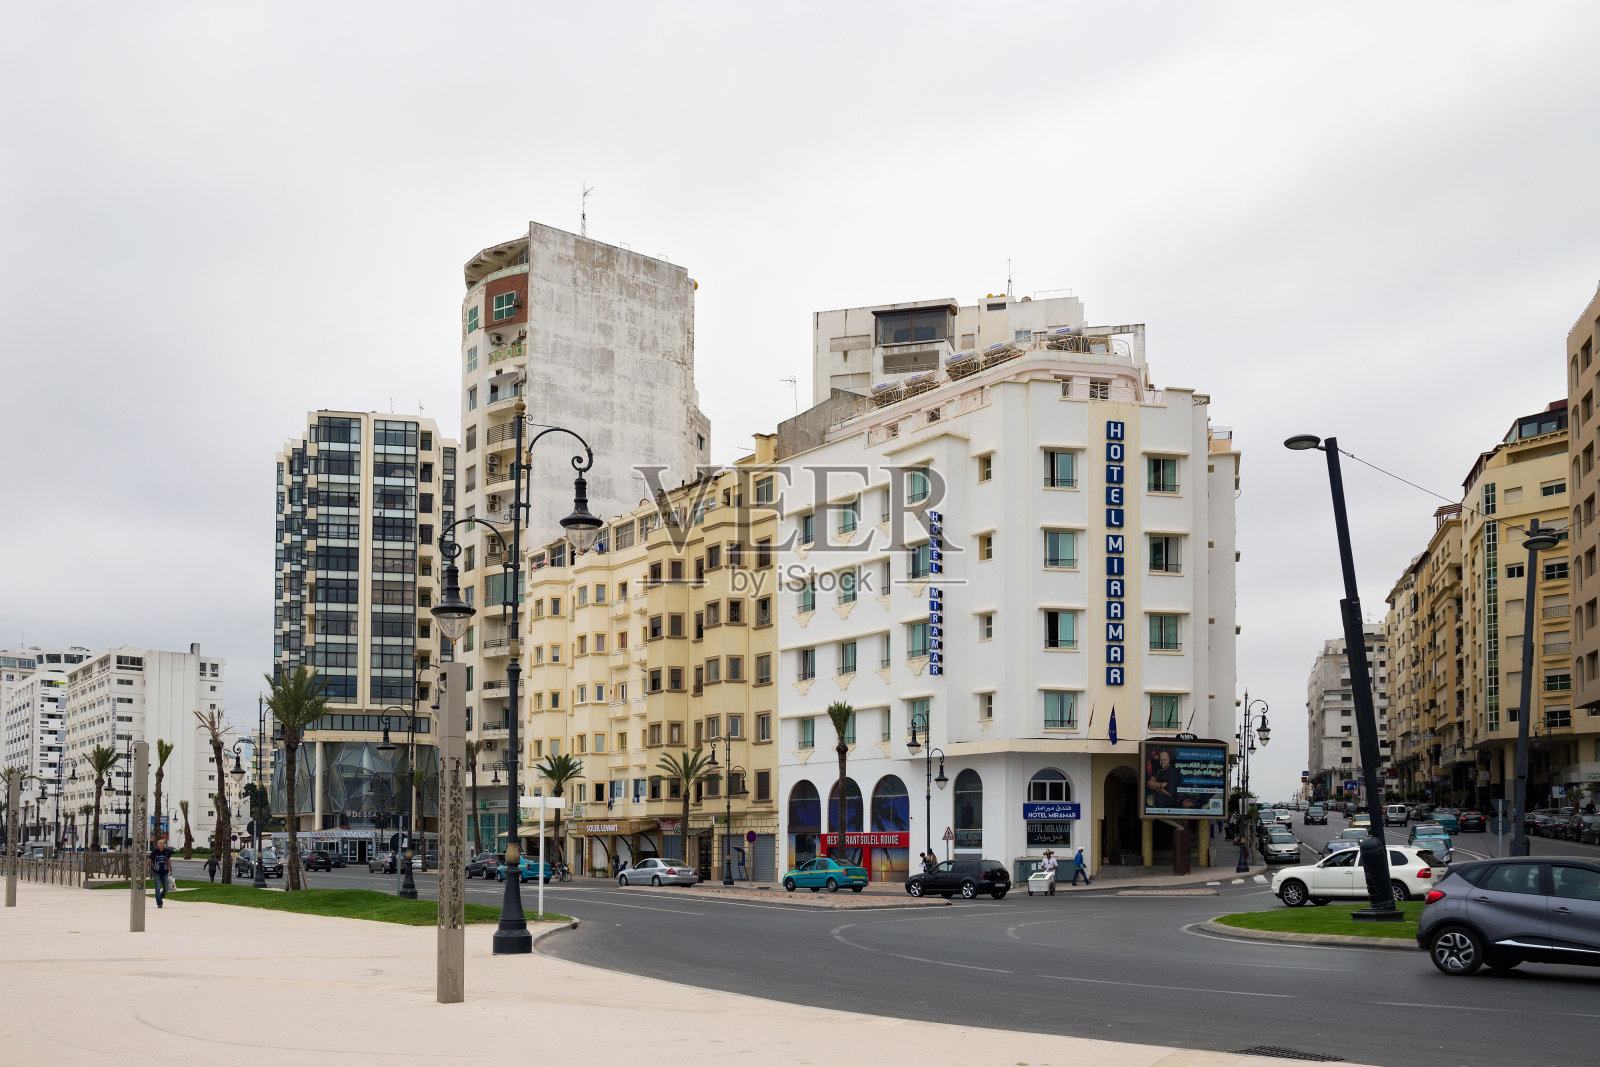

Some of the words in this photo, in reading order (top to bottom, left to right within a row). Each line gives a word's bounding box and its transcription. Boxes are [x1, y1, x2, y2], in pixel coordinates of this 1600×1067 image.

[1108, 421, 1123, 526] HOTEL
[931, 512, 939, 574] HOTEL
[931, 588, 939, 675] MIRAMAR
[1108, 536, 1123, 685] MIRAMAR
[586, 824, 601, 833] SOLEIL
[601, 824, 619, 832] LEVANT
[826, 835, 860, 845] RESRANT
[860, 835, 879, 845] SOLEIL
[880, 834, 899, 845] ROUGE
